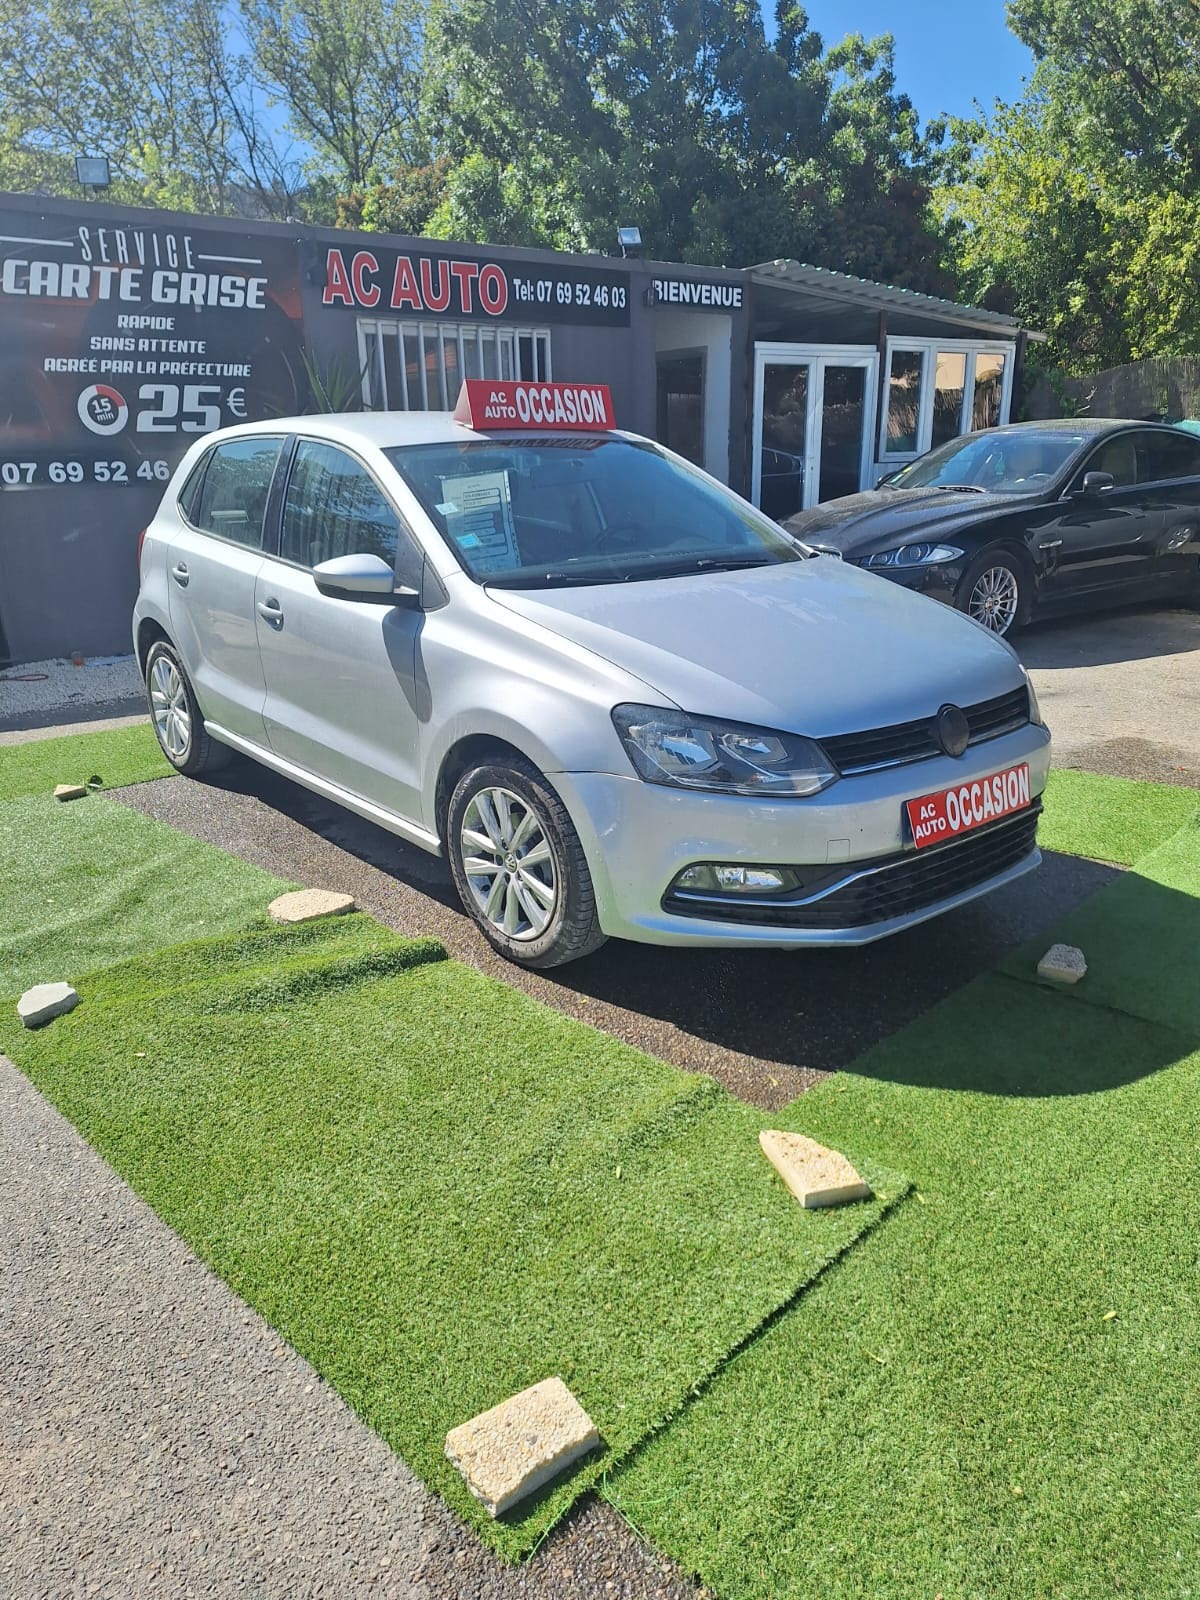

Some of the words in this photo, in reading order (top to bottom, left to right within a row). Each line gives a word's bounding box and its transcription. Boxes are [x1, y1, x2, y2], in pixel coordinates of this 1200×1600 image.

[78, 226, 194, 270] SERVICE
[2, 259, 144, 301] CARTE
[151, 271, 268, 309] GRISE
[322, 249, 381, 308] AC
[390, 255, 508, 315] AUTO
[513, 278, 534, 301] Tel:
[536, 280, 553, 303] 07
[556, 281, 572, 304] 69
[575, 283, 591, 306] 52
[594, 285, 609, 307] 46
[611, 286, 626, 308] 03
[652, 279, 743, 307] BIENVENUE
[117, 314, 176, 330] RAPIDE
[90, 336, 136, 351] SANS
[138, 338, 207, 354] ATTENTE
[44, 356, 97, 374] AGRÉÉ
[100, 360, 134, 374] PAR
[136, 361, 156, 374] LA
[159, 359, 251, 377] PRÉFECTURE
[91, 397, 112, 414] 15
[136, 383, 222, 432] 25
[226, 387, 248, 417] €
[490, 391, 507, 404] AC
[515, 387, 607, 423] OCCASION
[97, 411, 115, 422] min
[484, 406, 516, 419] AUTO
[2, 462, 38, 484] 07
[49, 462, 84, 482] 69
[94, 461, 129, 482] 52
[136, 460, 170, 480] 46
[945, 766, 1030, 831] OCCASION
[920, 803, 936, 820] AC
[915, 816, 946, 839] AUTO
